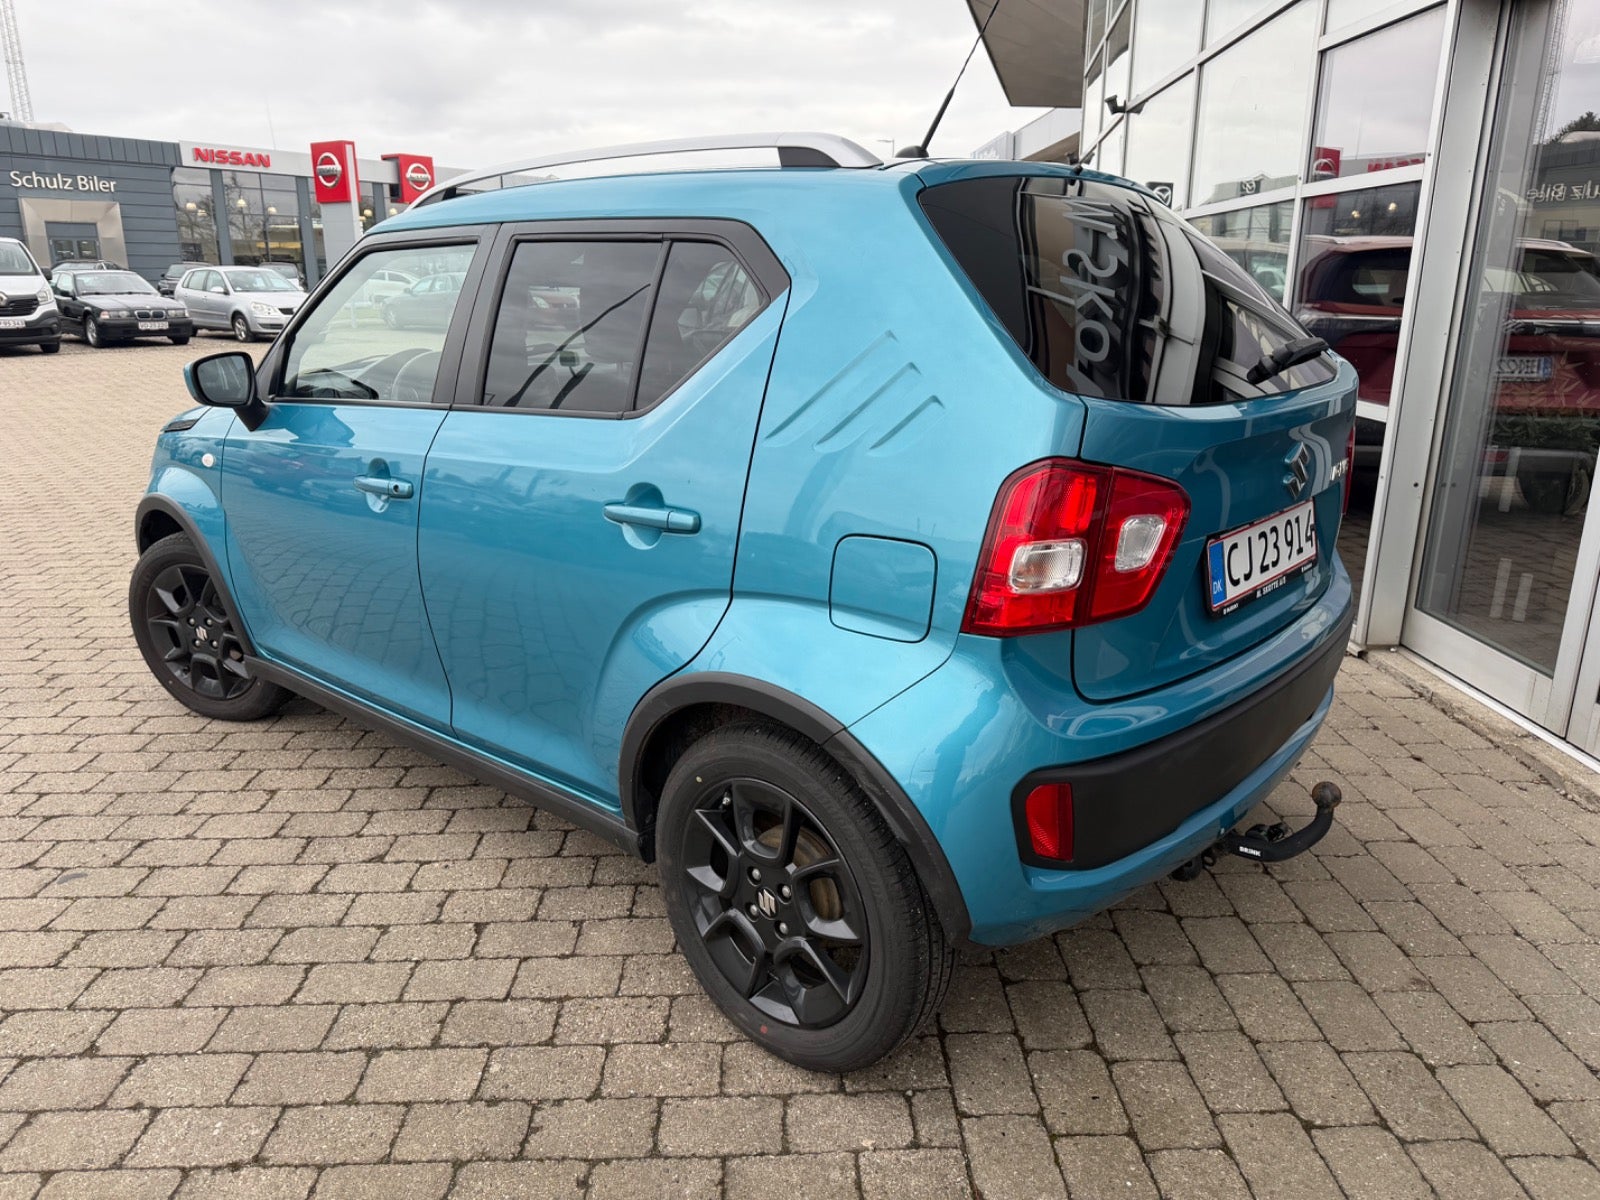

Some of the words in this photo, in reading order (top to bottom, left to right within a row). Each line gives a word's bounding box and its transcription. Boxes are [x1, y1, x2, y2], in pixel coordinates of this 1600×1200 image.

[193, 147, 271, 168] NISSAN
[9, 170, 74, 190] Schulz
[76, 175, 117, 192] Biler
[1227, 536, 1253, 587] CJ
[1258, 526, 1280, 574] 23
[1284, 509, 1315, 560] 914
[1213, 579, 1222, 595] DK
